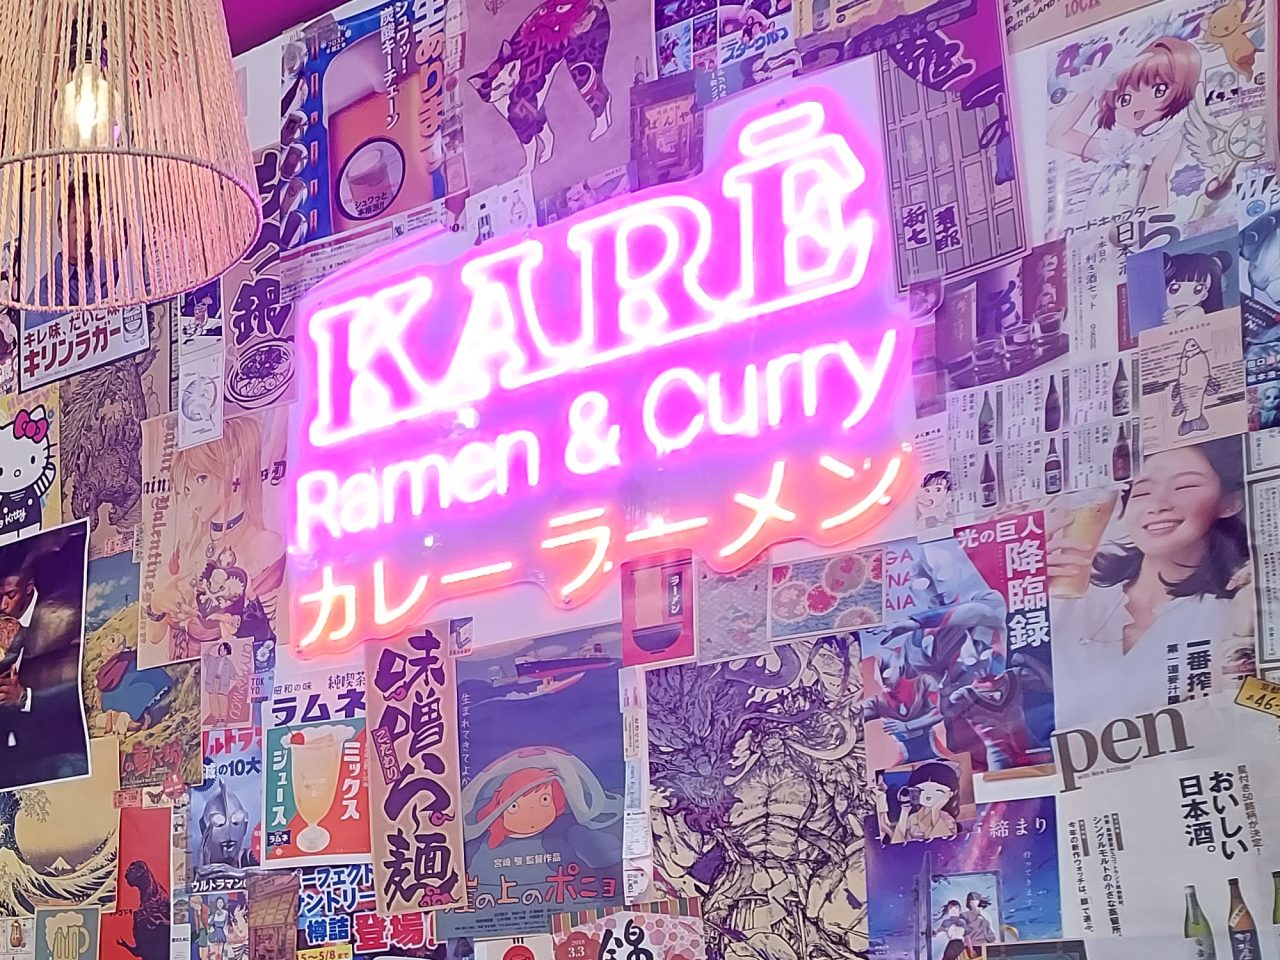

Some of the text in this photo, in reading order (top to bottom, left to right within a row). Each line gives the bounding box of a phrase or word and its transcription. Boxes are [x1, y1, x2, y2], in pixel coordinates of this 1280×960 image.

[23, 319, 122, 378] キリンラガー
[295, 427, 540, 552] Ramen
[564, 390, 620, 476] &
[642, 328, 898, 456] Curry
[6, 508, 27, 526] Kitty
[957, 515, 1044, 548] 光の巨人
[299, 456, 902, 651] カレーラーメン
[670, 574, 682, 614] ラーメン
[1005, 538, 1051, 650] 降臨録
[251, 677, 265, 686] TOK
[251, 686, 261, 694] YO
[273, 682, 312, 695] 昭和の味
[272, 688, 366, 727] ラムネ
[1049, 706, 1196, 794] pen
[271, 751, 288, 826] ジュース
[340, 741, 361, 820] ミックス
[1208, 770, 1249, 861] おいしい
[306, 915, 351, 944] 樽詰
